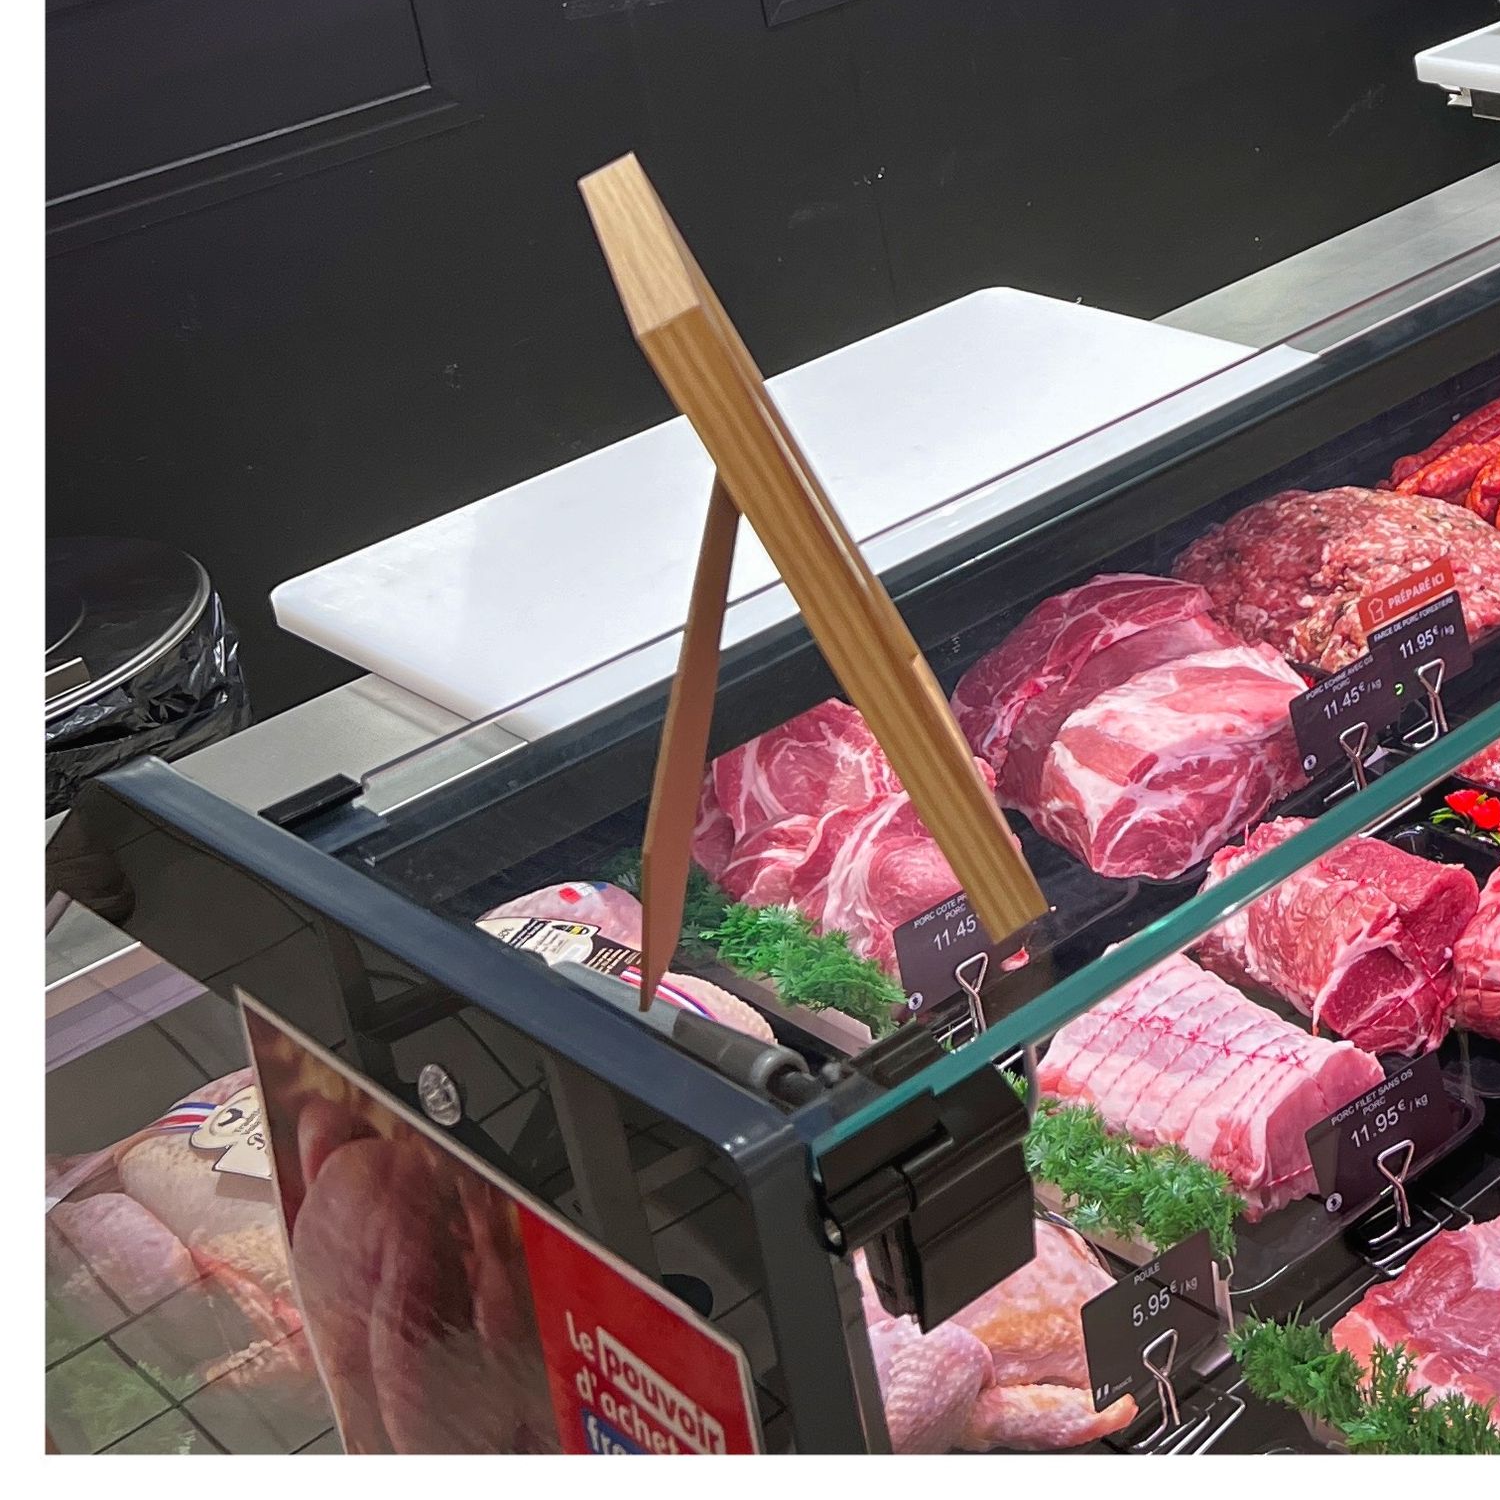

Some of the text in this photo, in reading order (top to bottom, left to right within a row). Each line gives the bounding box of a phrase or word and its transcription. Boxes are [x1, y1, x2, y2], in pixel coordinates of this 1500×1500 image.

[1388, 572, 1445, 609] PRÉPARÉ ICI
[913, 912, 935, 929] PORC
[936, 899, 956, 915] COTE
[945, 904, 967, 920] PORC
[1330, 1068, 1414, 1126] PORC FILET SANS OS
[1362, 1096, 1387, 1116] PORC
[1133, 1262, 1161, 1286] POULE
[566, 1310, 596, 1363] le
